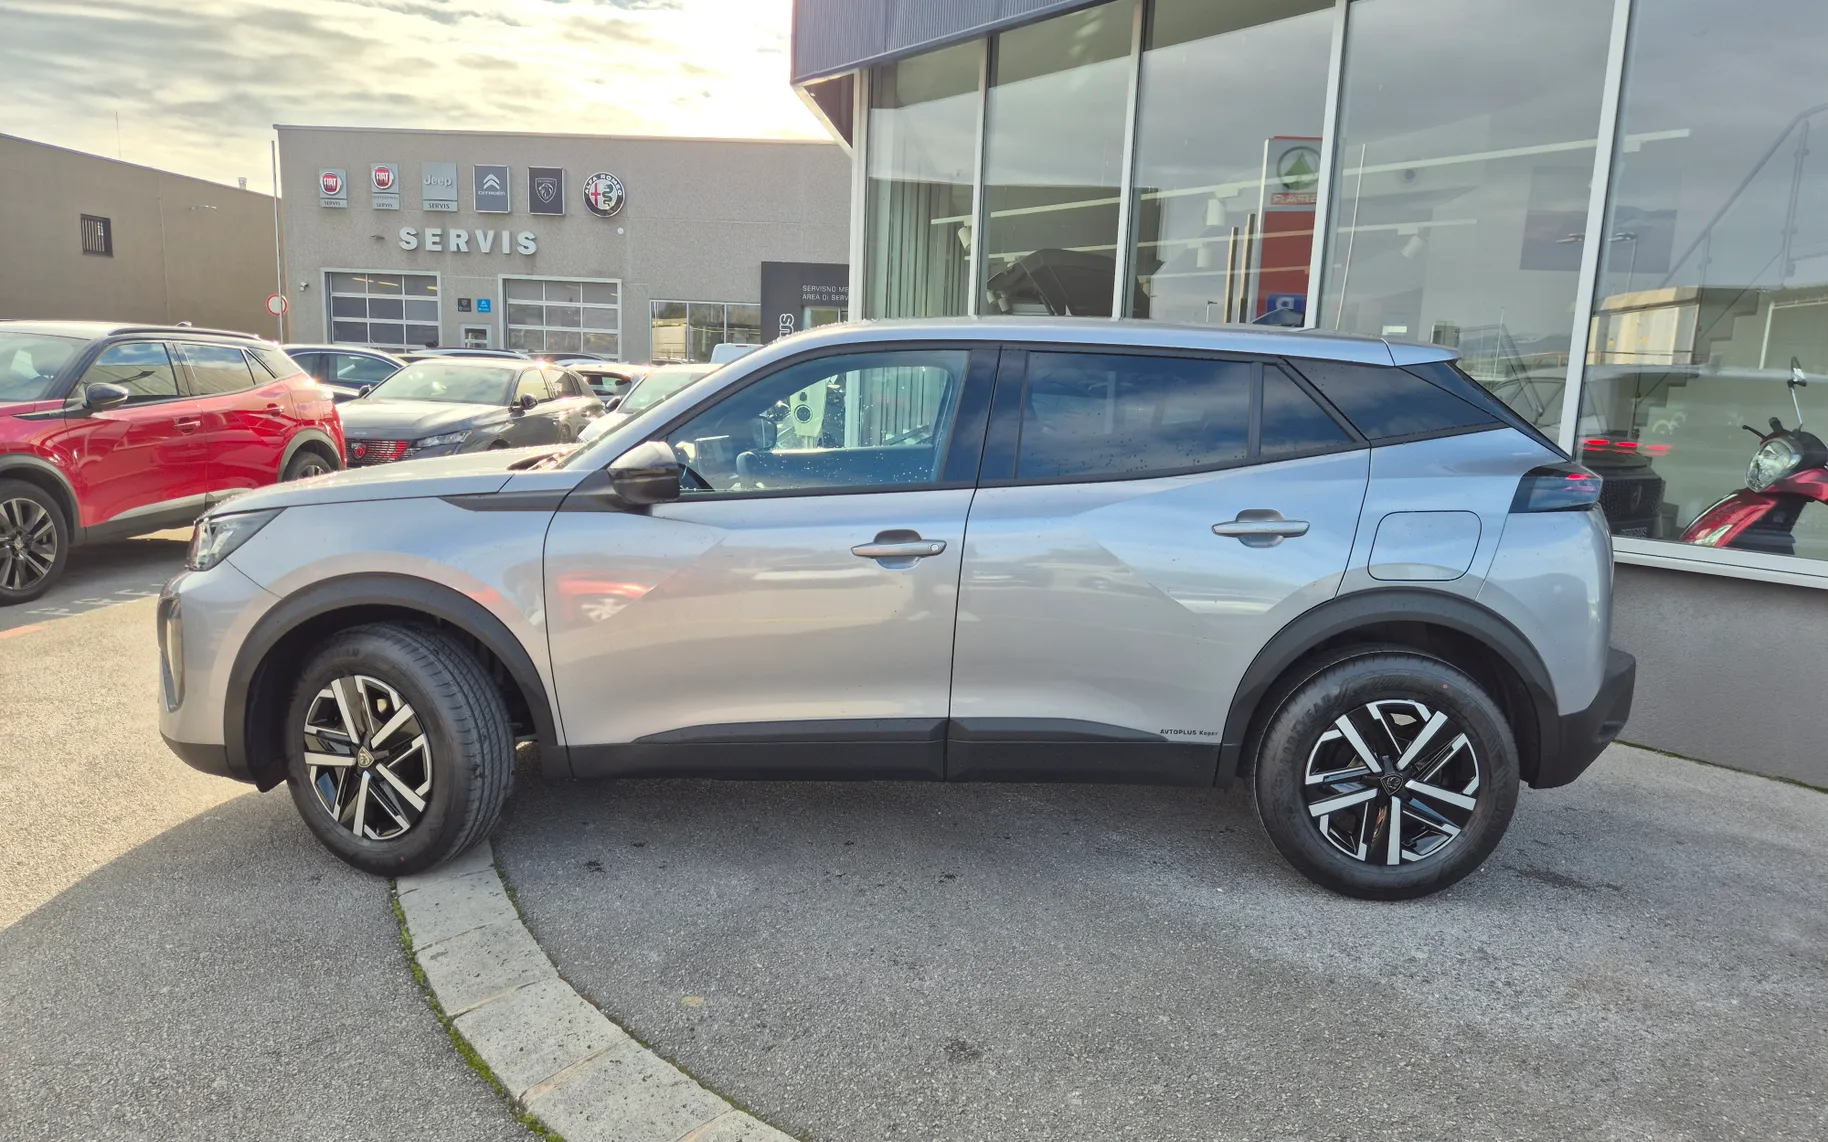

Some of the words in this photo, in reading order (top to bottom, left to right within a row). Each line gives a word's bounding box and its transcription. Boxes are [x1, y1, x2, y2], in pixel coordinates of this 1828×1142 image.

[323, 177, 337, 187] FIAT
[376, 172, 389, 182] FIAT
[424, 174, 453, 188] Jeep
[584, 176, 599, 195] ALFA
[600, 174, 623, 196] ROMEO
[399, 226, 538, 256] SERVIS
[1160, 728, 1197, 736] AVTOPLUS
